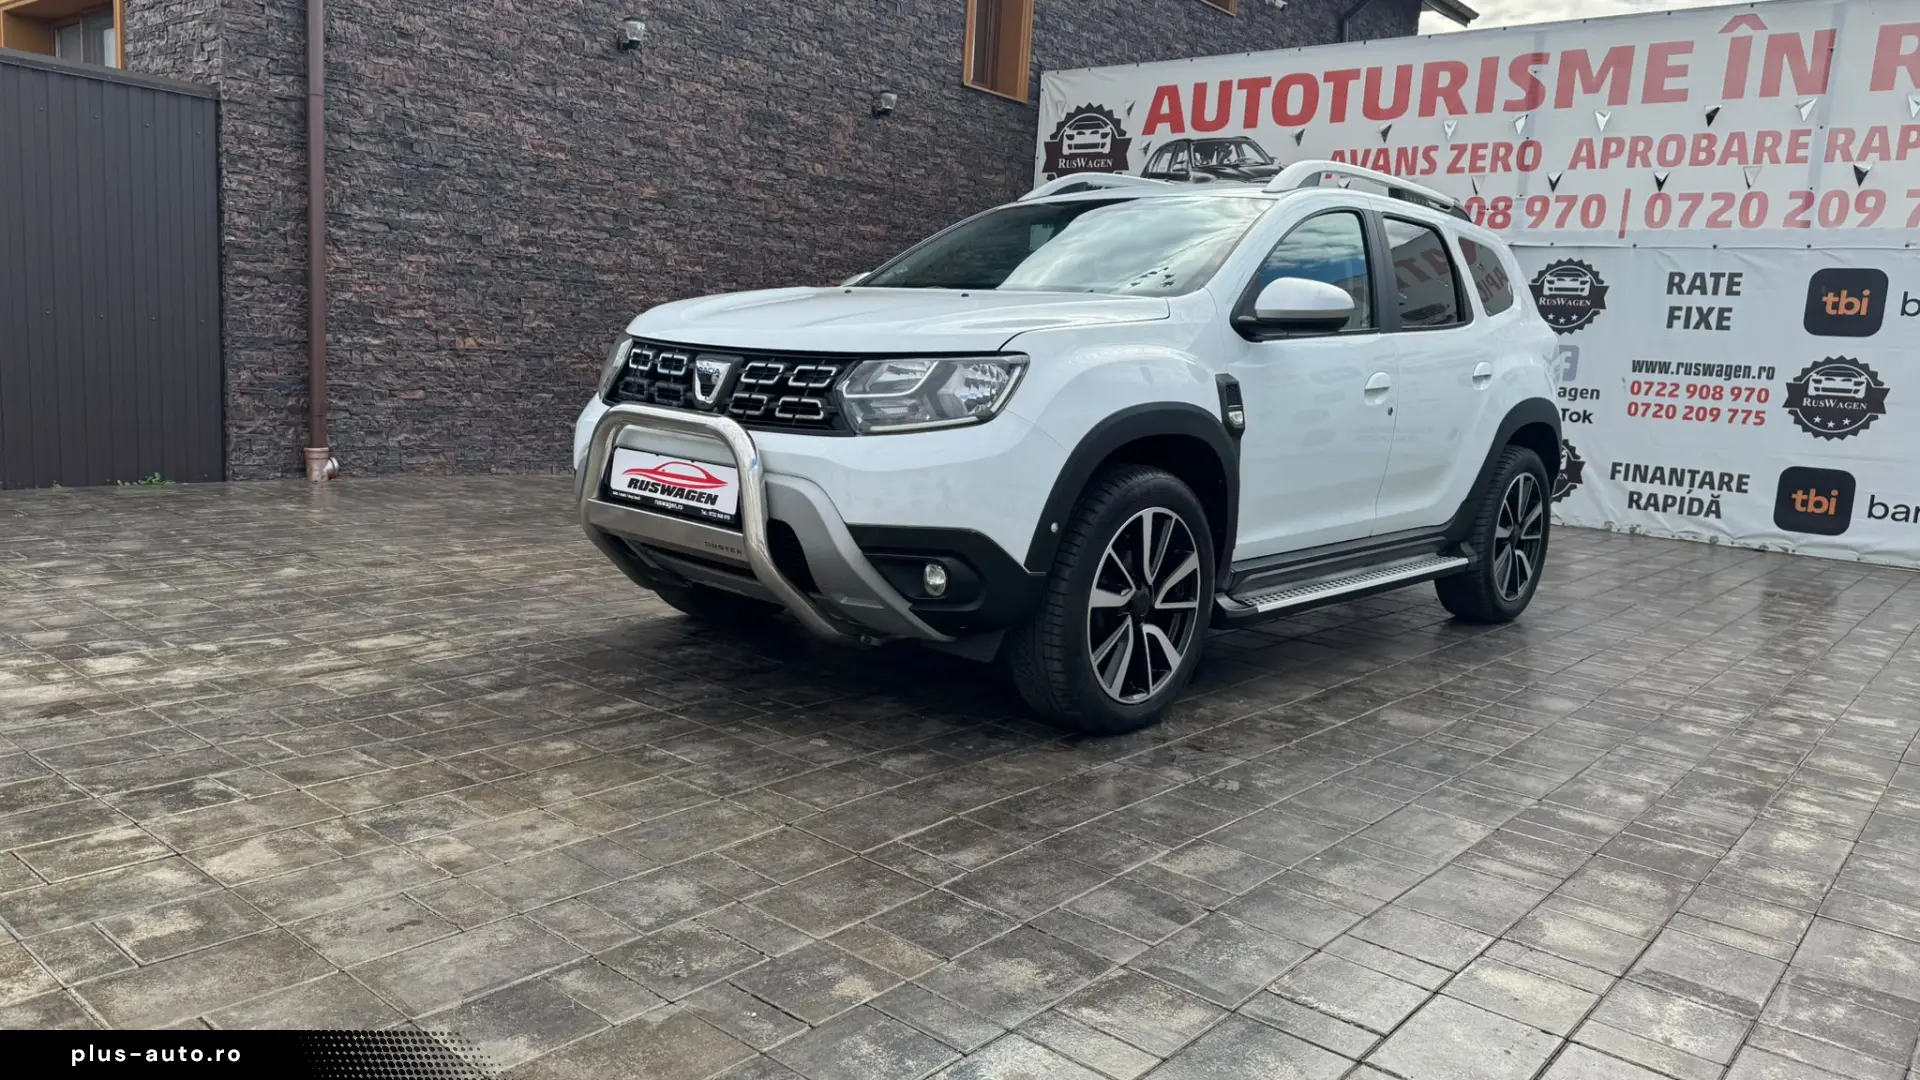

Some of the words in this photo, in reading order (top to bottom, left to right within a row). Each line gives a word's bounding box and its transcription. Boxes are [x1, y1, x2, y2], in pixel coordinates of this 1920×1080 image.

[1142, 40, 1694, 136] AUTOTURISME
[1717, 13, 1836, 99] ÎN
[1869, 22, 1920, 91] R
[1446, 140, 1542, 174] ZERO
[1568, 128, 1812, 170] APROBARE
[1824, 124, 1920, 163] RAP
[1464, 196, 1512, 230] 08
[1524, 193, 1606, 229] 970
[1643, 190, 1769, 230] 0720
[1782, 188, 1887, 230] 209
[1666, 271, 1743, 297] RATE
[1821, 288, 1871, 316] tbi
[1665, 305, 1733, 331] FIXE
[1631, 359, 1776, 381] www.ruswagen.ro
[1557, 386, 1600, 401] agen
[1630, 380, 1680, 398] 0722
[1685, 383, 1724, 401] 908
[1730, 386, 1770, 404] 970
[1560, 408, 1594, 424] Tok
[1627, 401, 1677, 419] 0720
[1682, 405, 1721, 422] 209
[1727, 408, 1766, 426] 775
[627, 477, 719, 506] RUSWAGEN
[1791, 488, 1839, 516] tbi
